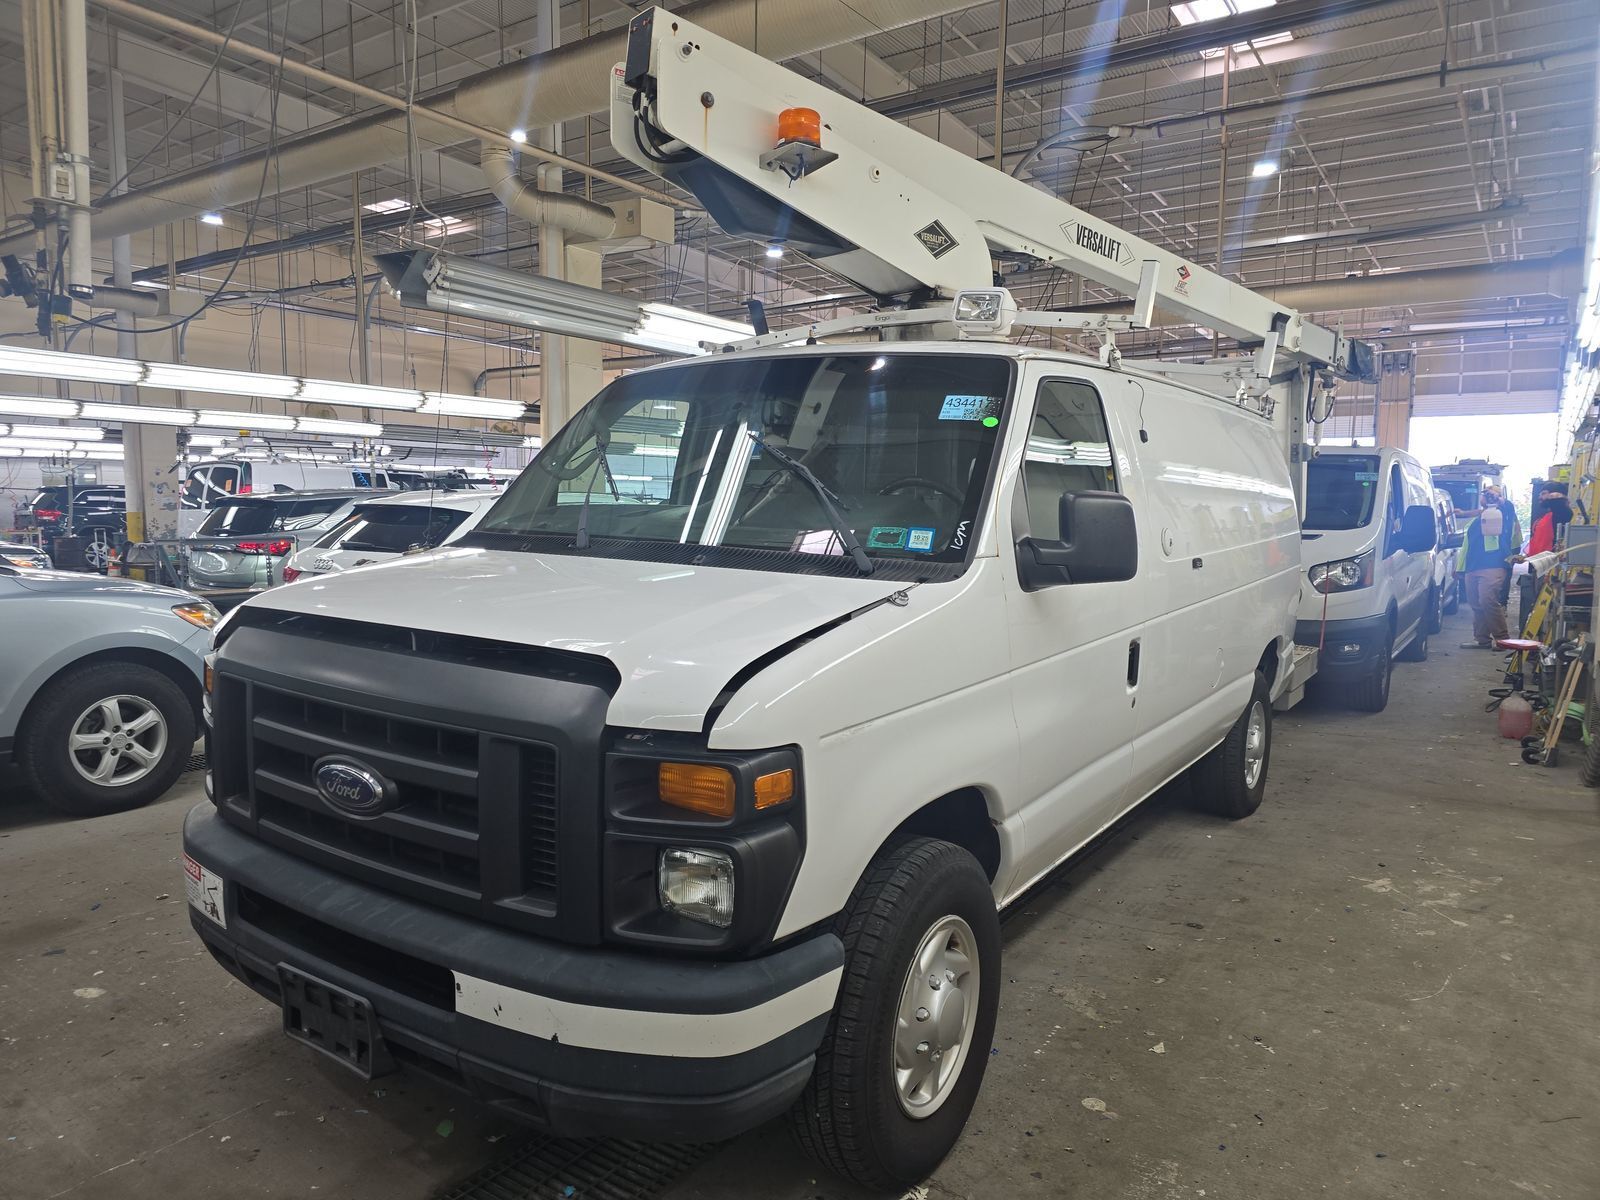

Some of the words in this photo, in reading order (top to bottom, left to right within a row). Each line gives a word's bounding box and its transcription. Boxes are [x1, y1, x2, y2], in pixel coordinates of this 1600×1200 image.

[920, 232, 945, 244] VERSALIFT
[1076, 223, 1121, 262] VERSALIFT
[326, 770, 361, 800] Ford
